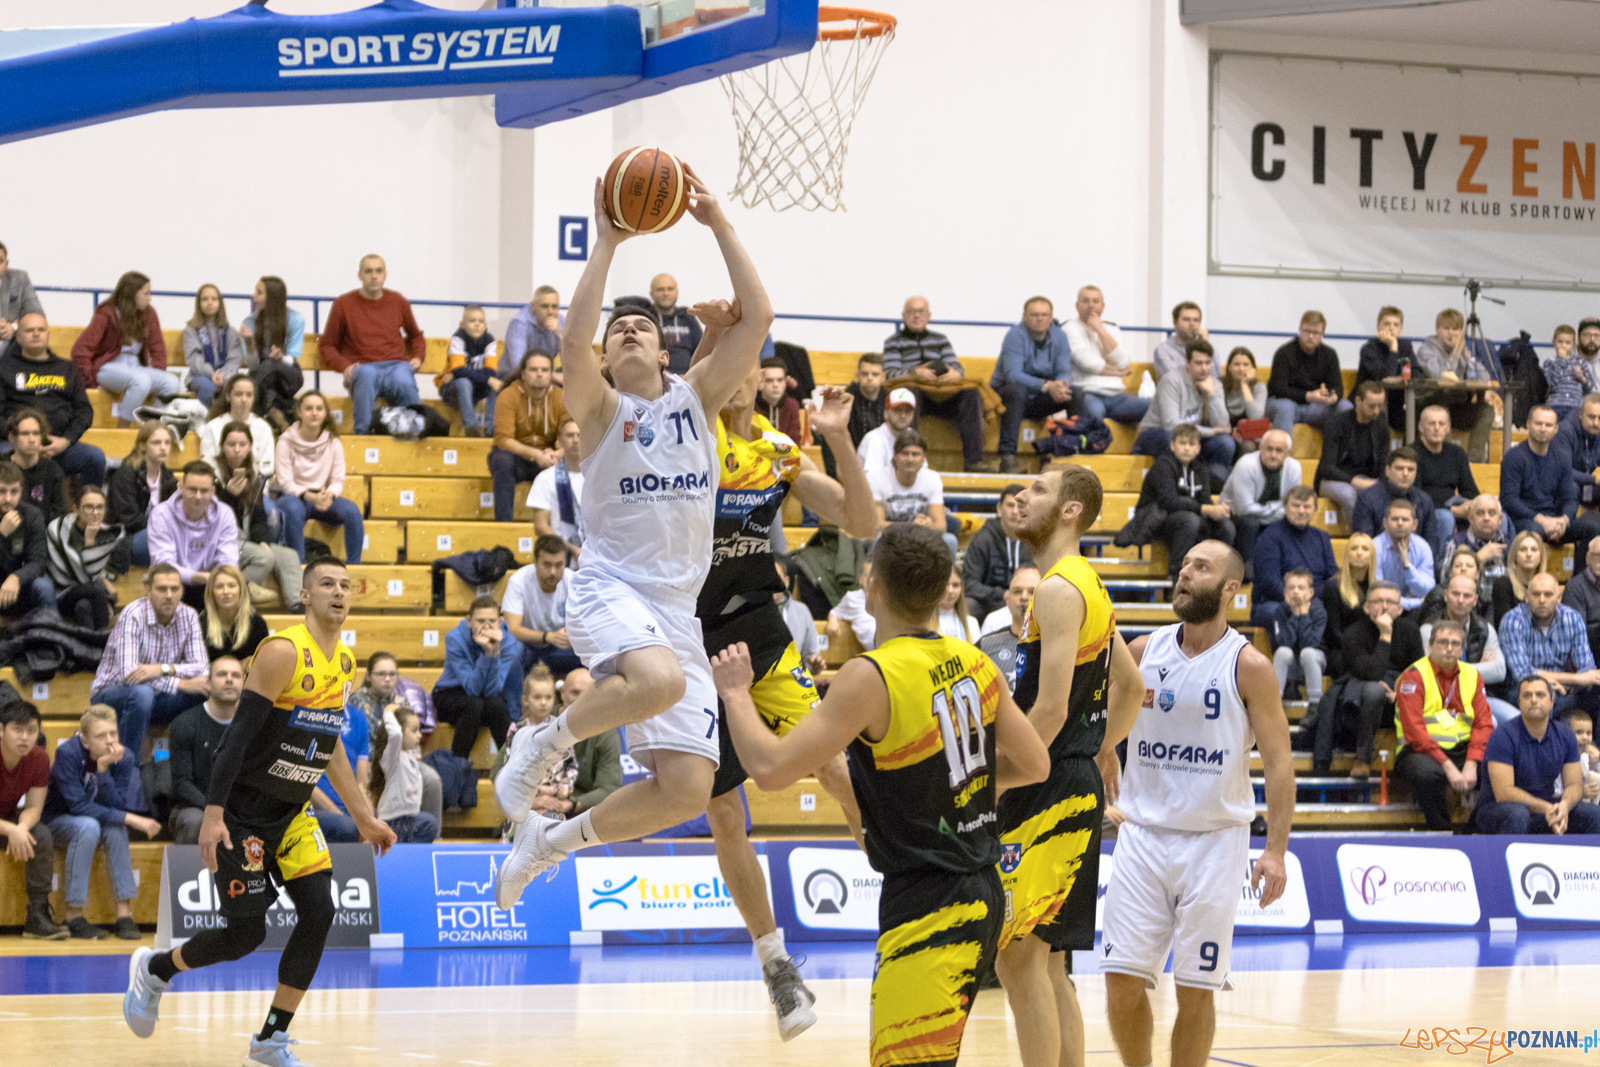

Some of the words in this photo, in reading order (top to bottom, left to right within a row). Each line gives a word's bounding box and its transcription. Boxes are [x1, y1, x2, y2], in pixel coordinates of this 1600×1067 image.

[278, 34, 405, 66] SPORT
[409, 24, 561, 70] SYSTEM
[1251, 121, 1597, 201] CITYZEN
[650, 165, 671, 216] molten
[1359, 194, 1416, 213] WIĘCEJ
[1426, 197, 1451, 213] NIŻ
[1461, 200, 1501, 217] KLUB
[1510, 203, 1597, 221] SPORTOWY
[564, 222, 583, 255] C
[668, 408, 699, 444] 71
[1211, 678, 1217, 687] C
[1204, 688, 1221, 720] 9
[932, 676, 987, 790] 10
[270, 763, 290, 777] BDS
[1161, 763, 1188, 772] zdrowie
[1189, 766, 1222, 776] pacjentów
[1394, 880, 1466, 896] posnania
[438, 902, 526, 928] HOTEL
[641, 900, 687, 909] biuro
[438, 928, 527, 942] POZNAŃSKI
[1199, 941, 1219, 972] 9
